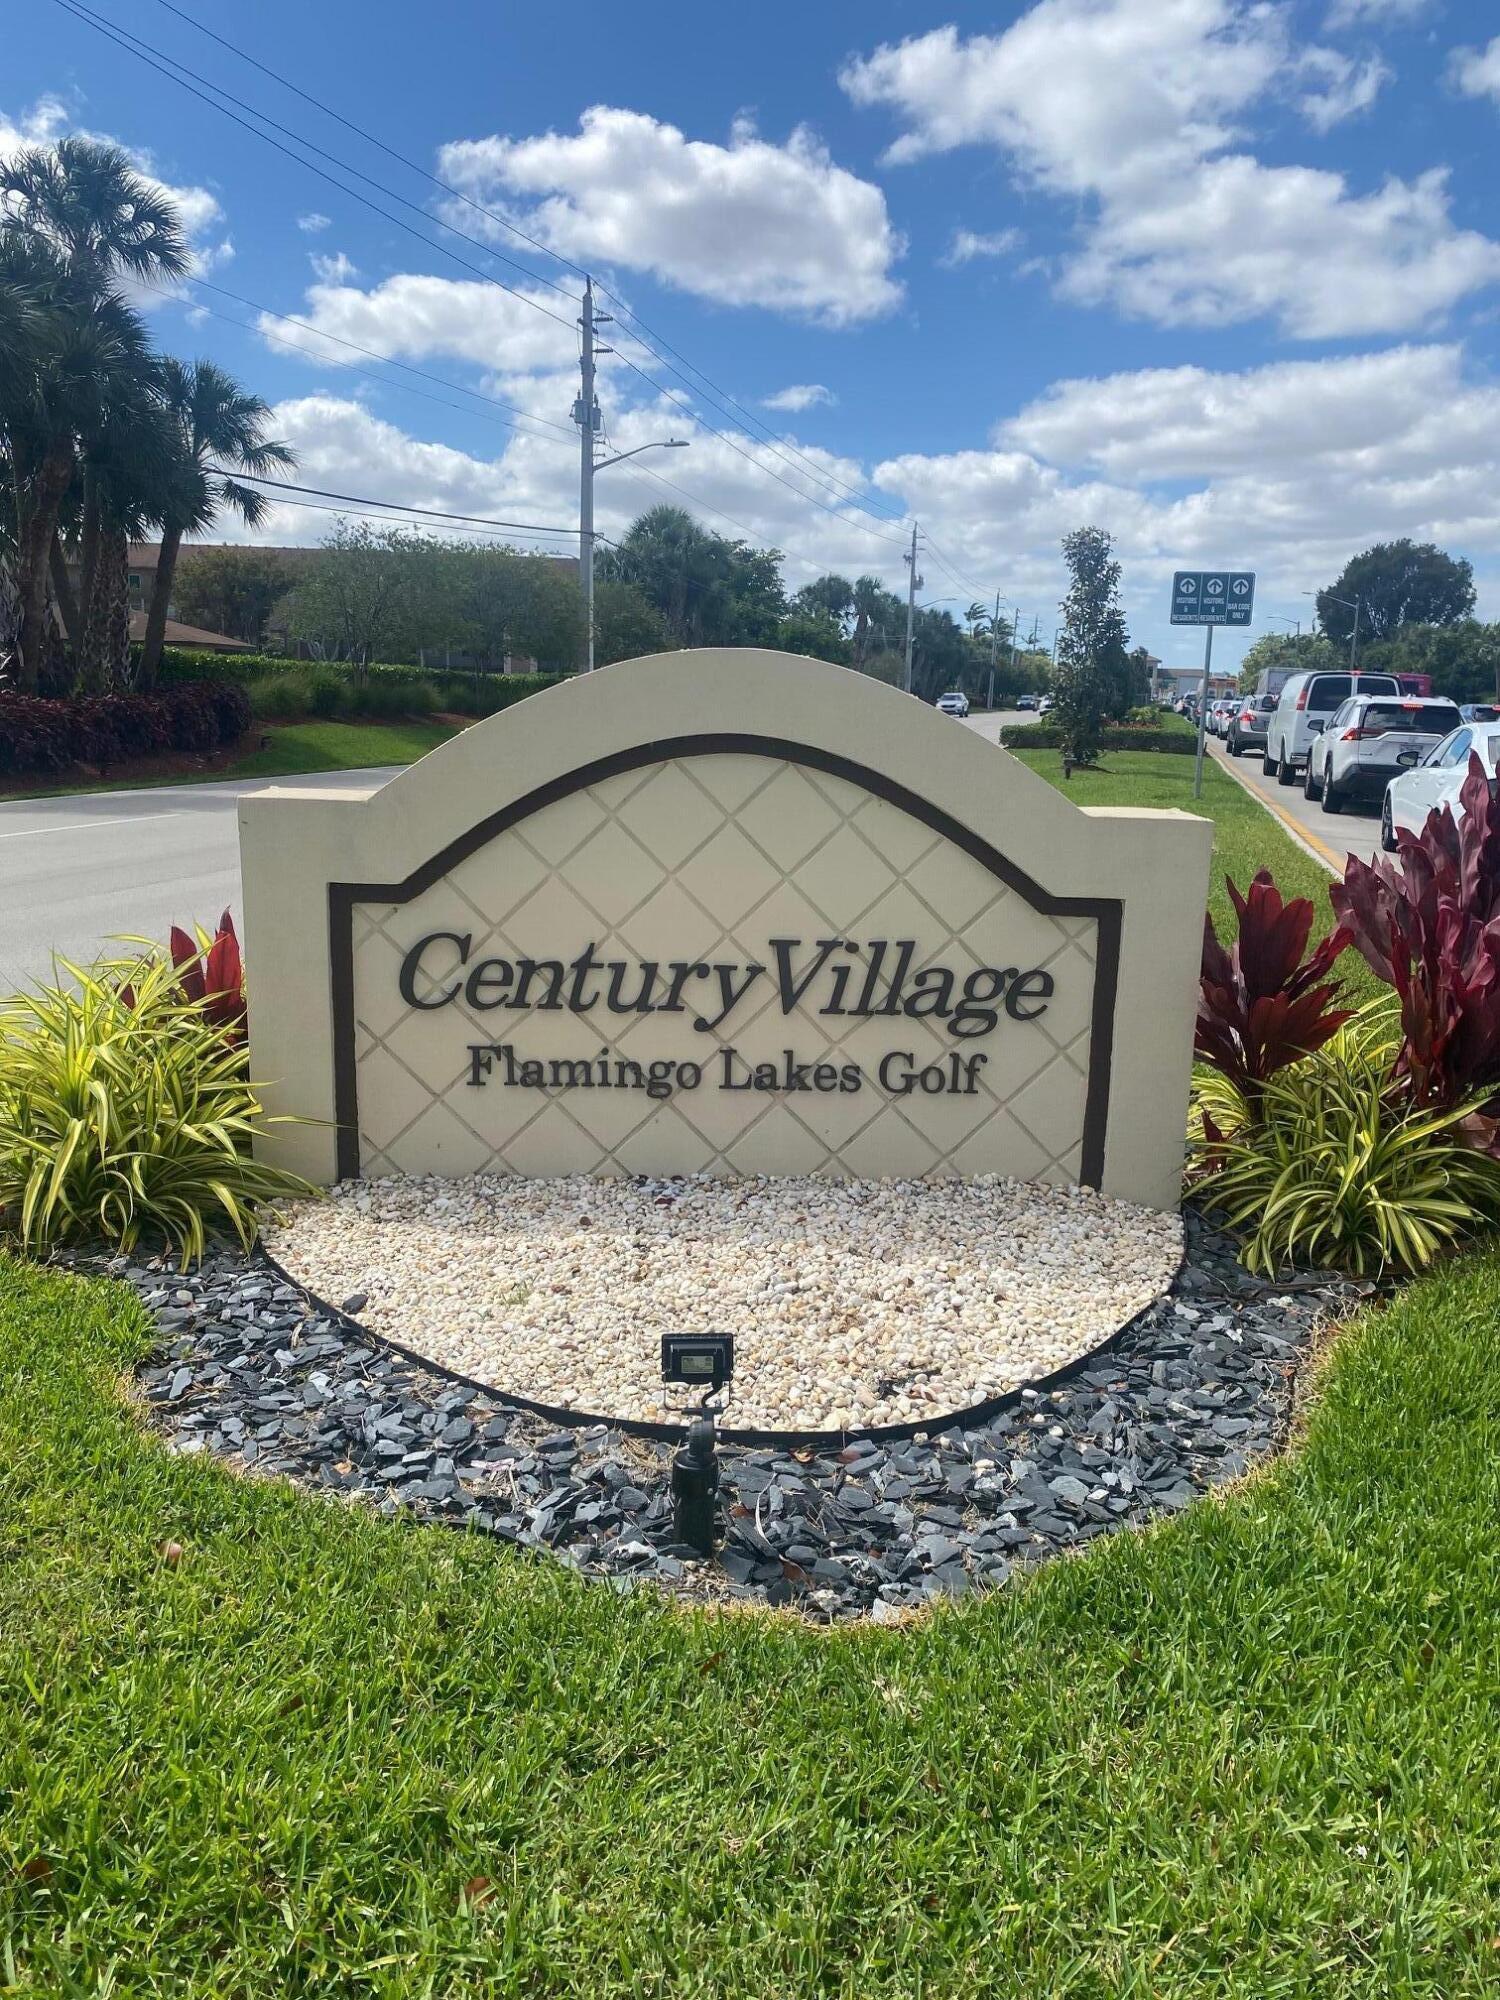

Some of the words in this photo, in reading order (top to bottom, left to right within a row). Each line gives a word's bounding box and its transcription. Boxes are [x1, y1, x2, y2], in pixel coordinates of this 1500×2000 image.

[398, 931, 768, 1033] Century
[767, 938, 1057, 1041] Village
[466, 1044, 703, 1101] Flamingo
[717, 1048, 863, 1094] Lakes
[878, 1051, 988, 1095] Golf
